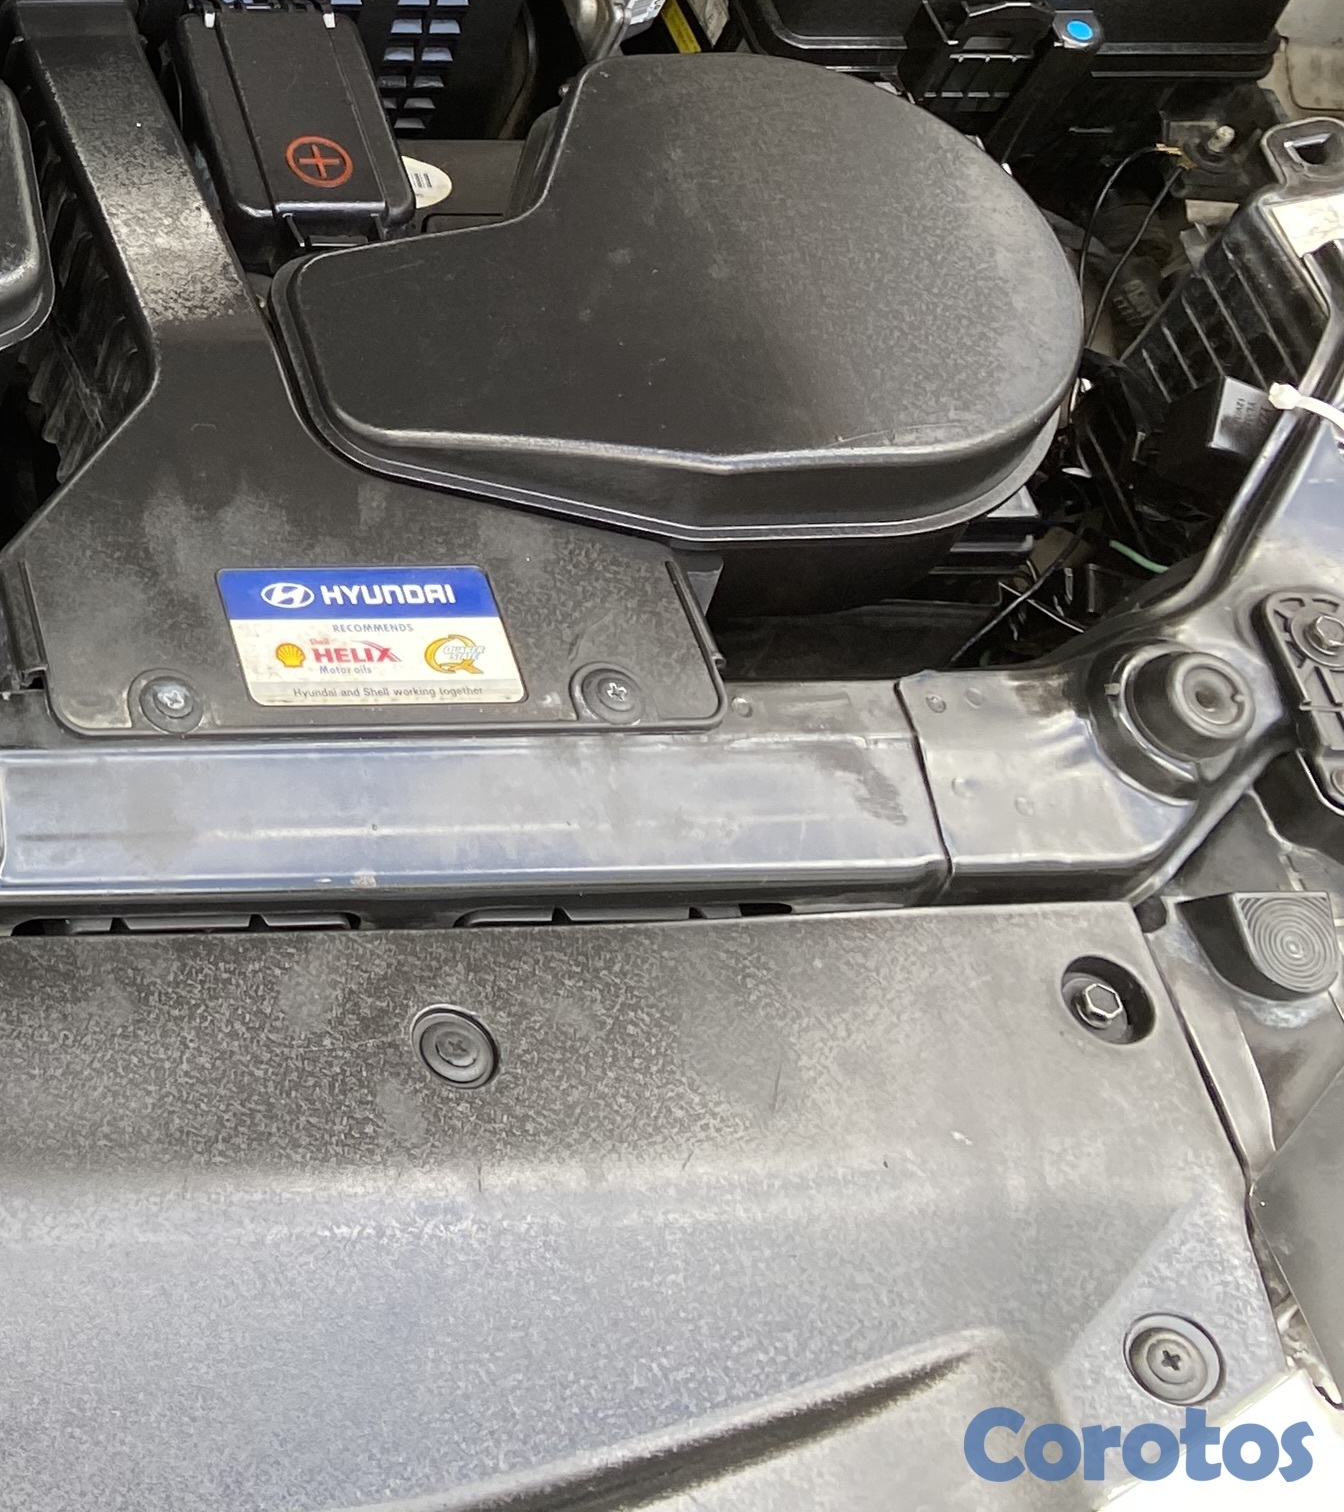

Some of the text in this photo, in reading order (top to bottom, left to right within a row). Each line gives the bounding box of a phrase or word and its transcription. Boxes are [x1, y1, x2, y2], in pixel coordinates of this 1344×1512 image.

[321, 584, 456, 605] HYUNDAI
[332, 623, 414, 633] RECOMMENDS
[313, 646, 402, 663] HELIX
[319, 665, 372, 675] Motor oils
[293, 686, 484, 699] Hyundai and Shell working together
